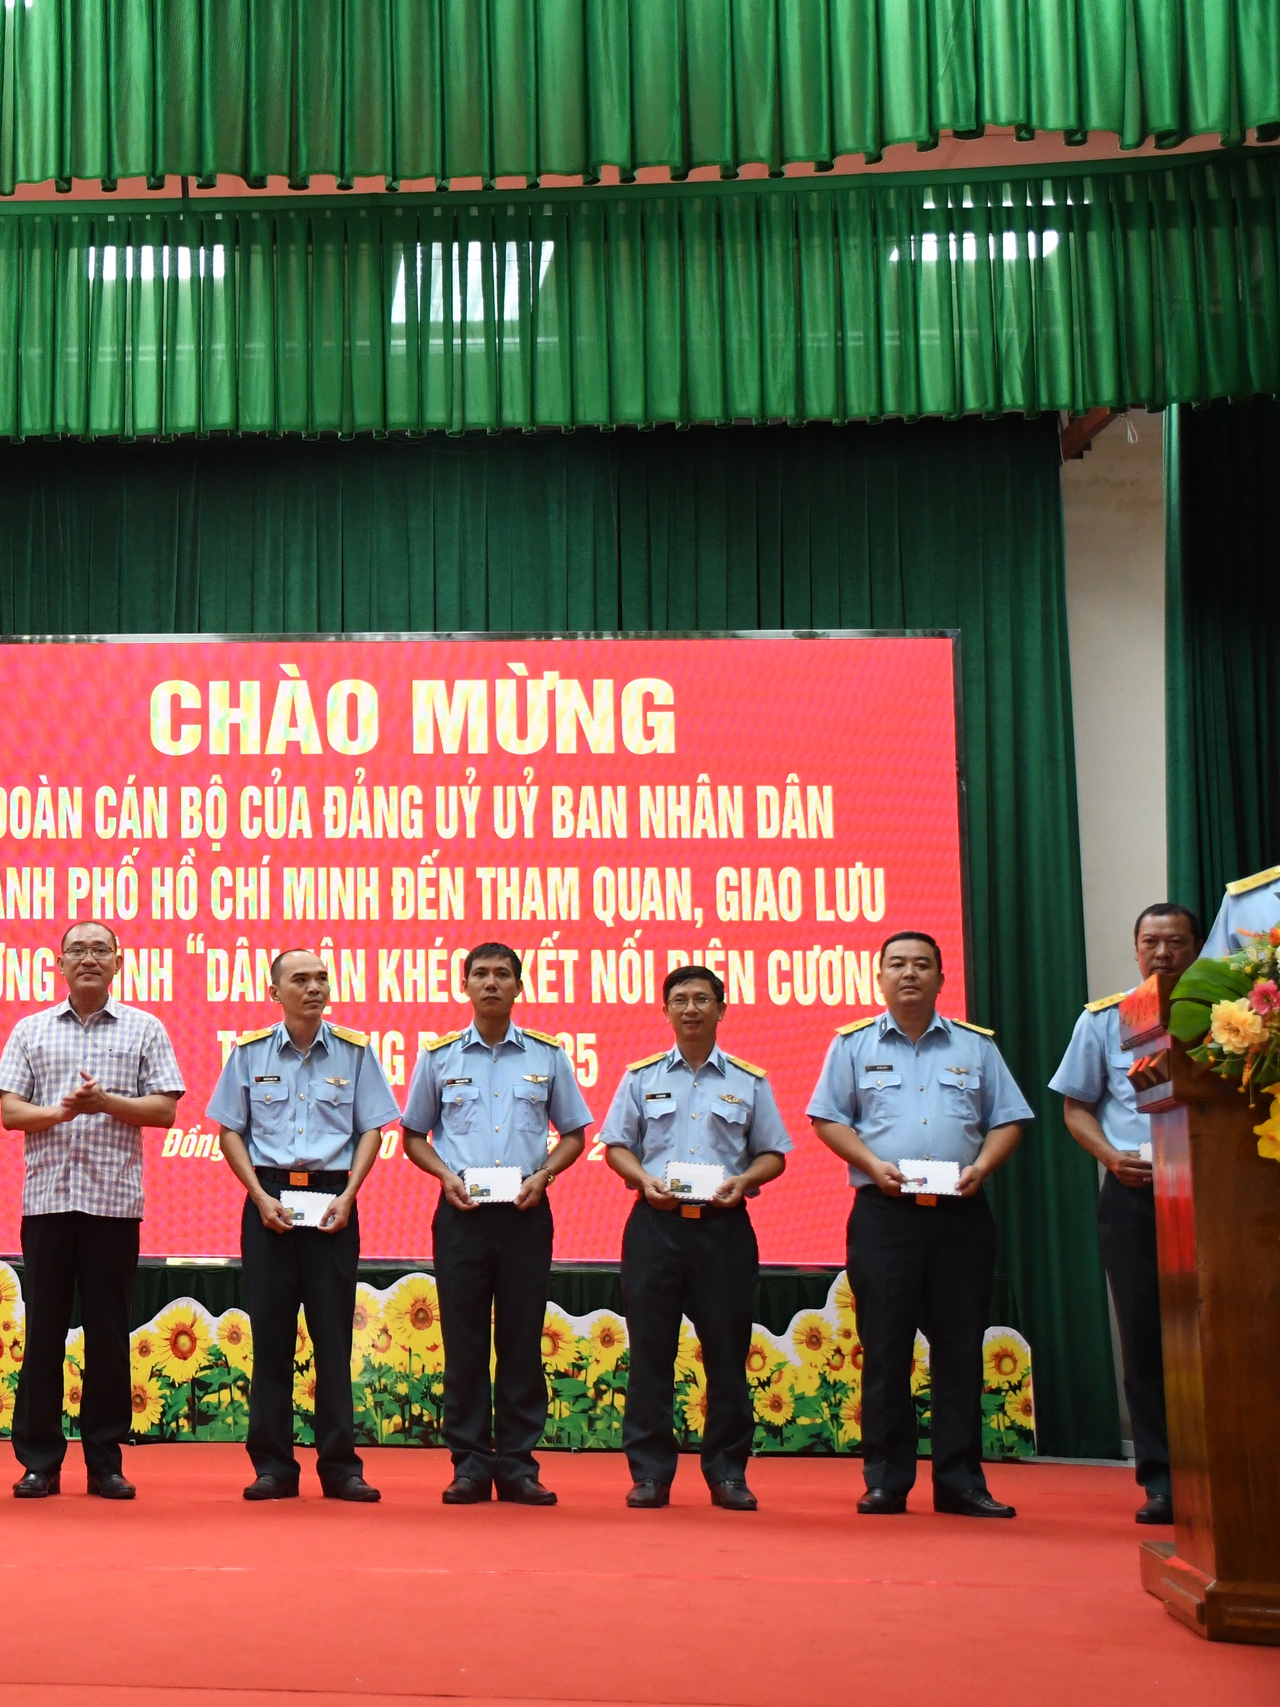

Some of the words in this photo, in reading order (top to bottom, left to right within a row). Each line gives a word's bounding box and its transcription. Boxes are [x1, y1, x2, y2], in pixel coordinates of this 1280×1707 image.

[150, 664, 378, 755] CHÀO
[412, 663, 675, 755] MỪNG
[95, 775, 167, 839] CÁN
[181, 775, 227, 852] BỘ
[240, 768, 312, 839] CỦA
[323, 767, 423, 839] ĐẢNG
[436, 767, 481, 839] UỶ
[494, 767, 539, 839] UỶ
[552, 786, 627, 838] BAN
[640, 774, 743, 838] NHÂN
[757, 773, 833, 838] DÂN
[68, 847, 139, 920] PHỐ
[152, 848, 197, 920] HỒ
[211, 855, 270, 920] CHÍ
[283, 867, 379, 920] MINH
[391, 849, 464, 920] ĐẾN
[476, 867, 580, 920] THAM
[593, 866, 703, 930] QUAN,
[716, 867, 802, 922] GIAO
[815, 862, 885, 922] LƯU
[514, 930, 579, 1004] KẾT
[591, 925, 654, 1004] NỐI
[161, 1124, 224, 1161] Đồng
